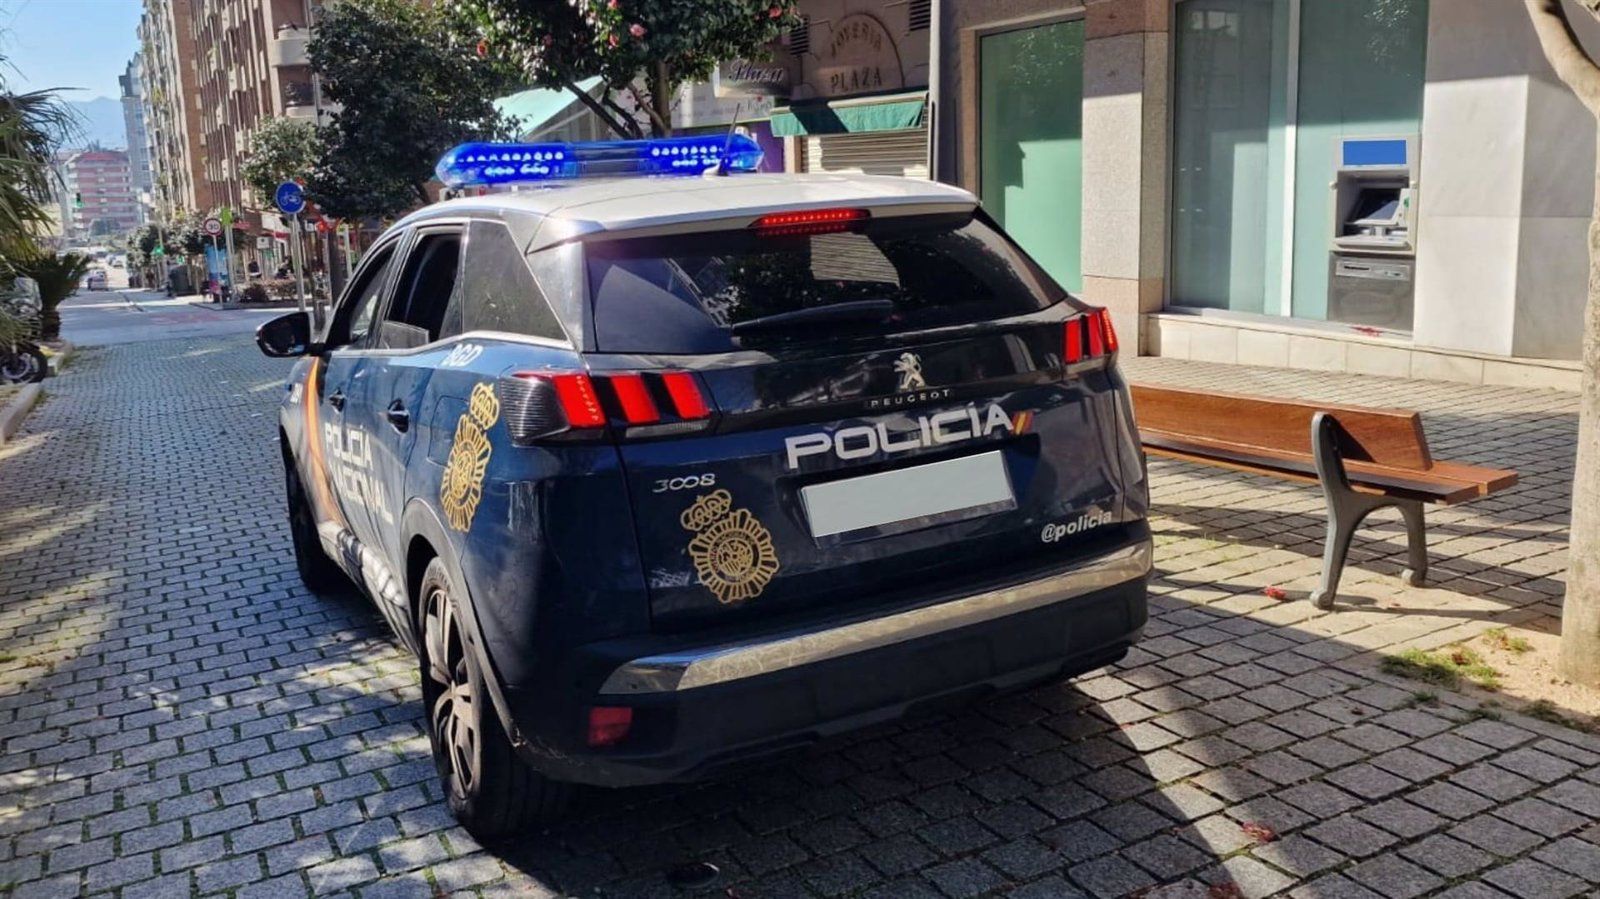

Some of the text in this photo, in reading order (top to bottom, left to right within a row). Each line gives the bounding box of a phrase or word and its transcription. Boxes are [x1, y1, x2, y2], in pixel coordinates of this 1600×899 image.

[831, 67, 882, 93] PLAZA
[871, 389, 950, 408] PEUGEOT
[652, 473, 716, 493] 3008
[1041, 509, 1112, 543] @policia
